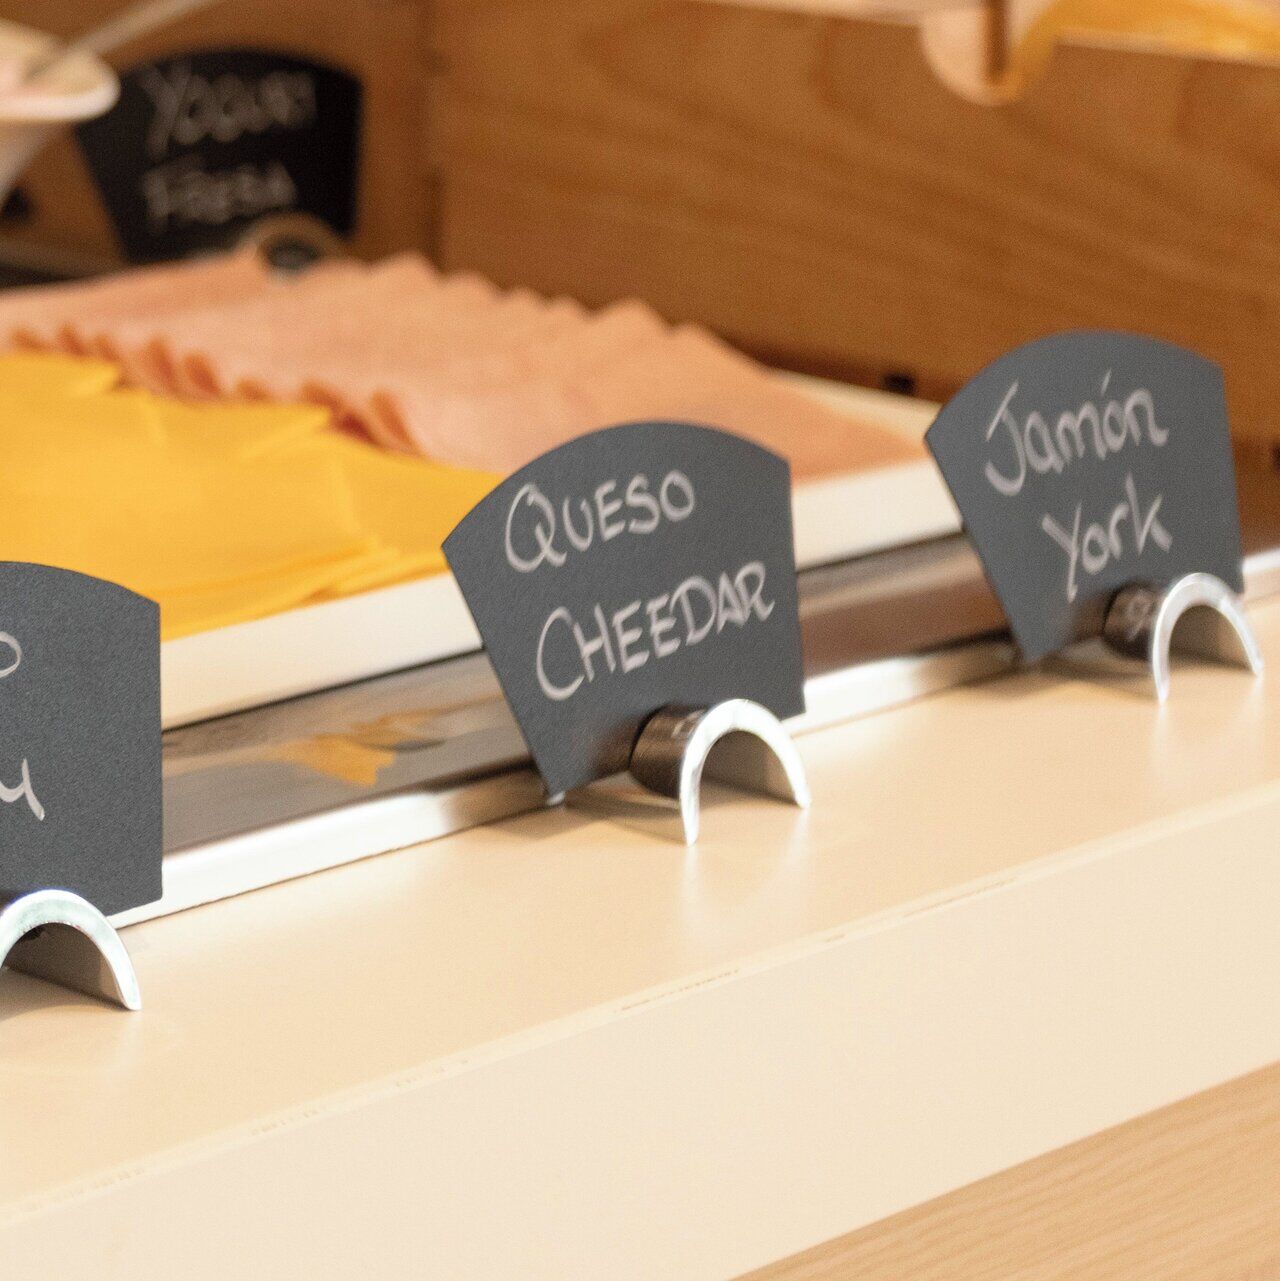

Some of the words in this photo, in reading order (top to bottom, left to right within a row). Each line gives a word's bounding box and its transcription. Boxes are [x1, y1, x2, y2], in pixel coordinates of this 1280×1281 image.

[985, 368, 1170, 496] Jamón
[504, 469, 696, 573] QUESO
[1041, 471, 1173, 603] York
[536, 560, 776, 702] CHEEDAR
